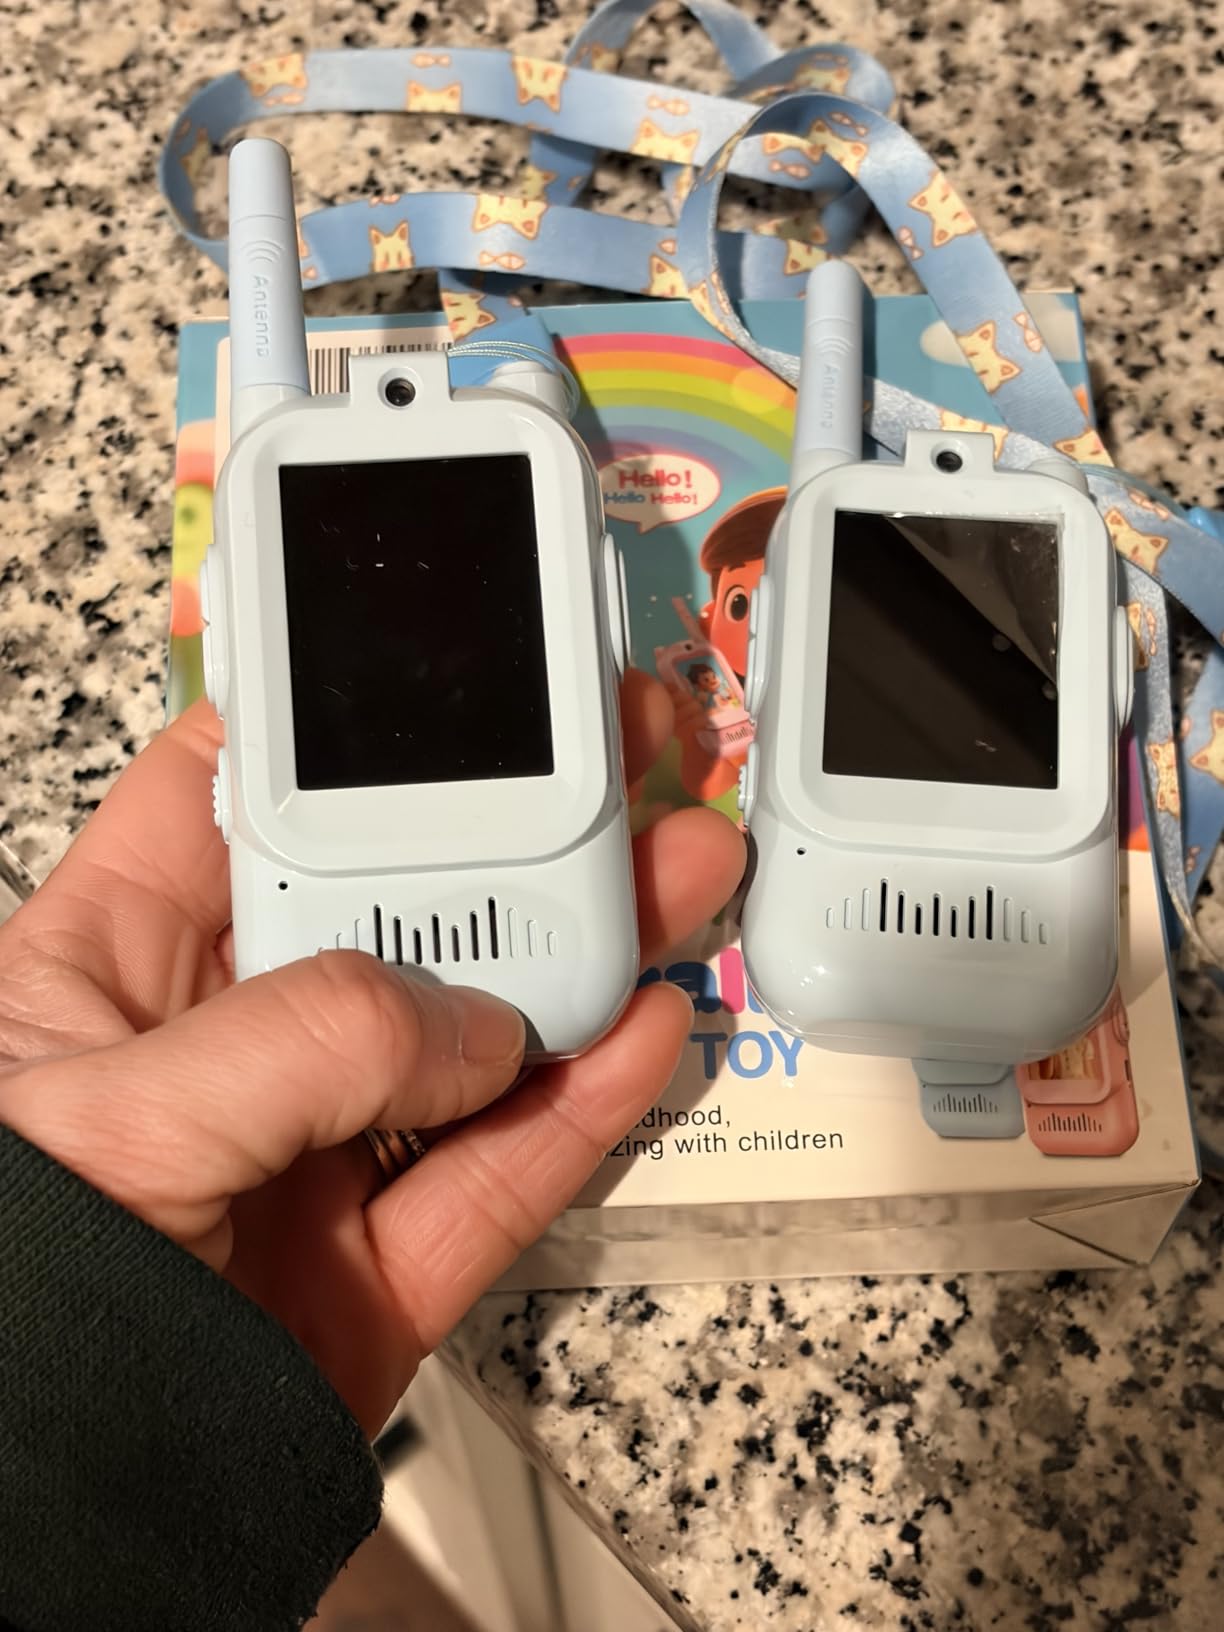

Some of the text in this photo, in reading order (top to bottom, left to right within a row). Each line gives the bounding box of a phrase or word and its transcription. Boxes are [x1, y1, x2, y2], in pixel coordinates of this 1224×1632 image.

[690, 1030, 805, 1080] TOY
[634, 1105, 731, 1129] dhood,
[606, 1129, 844, 1160] zing with children
